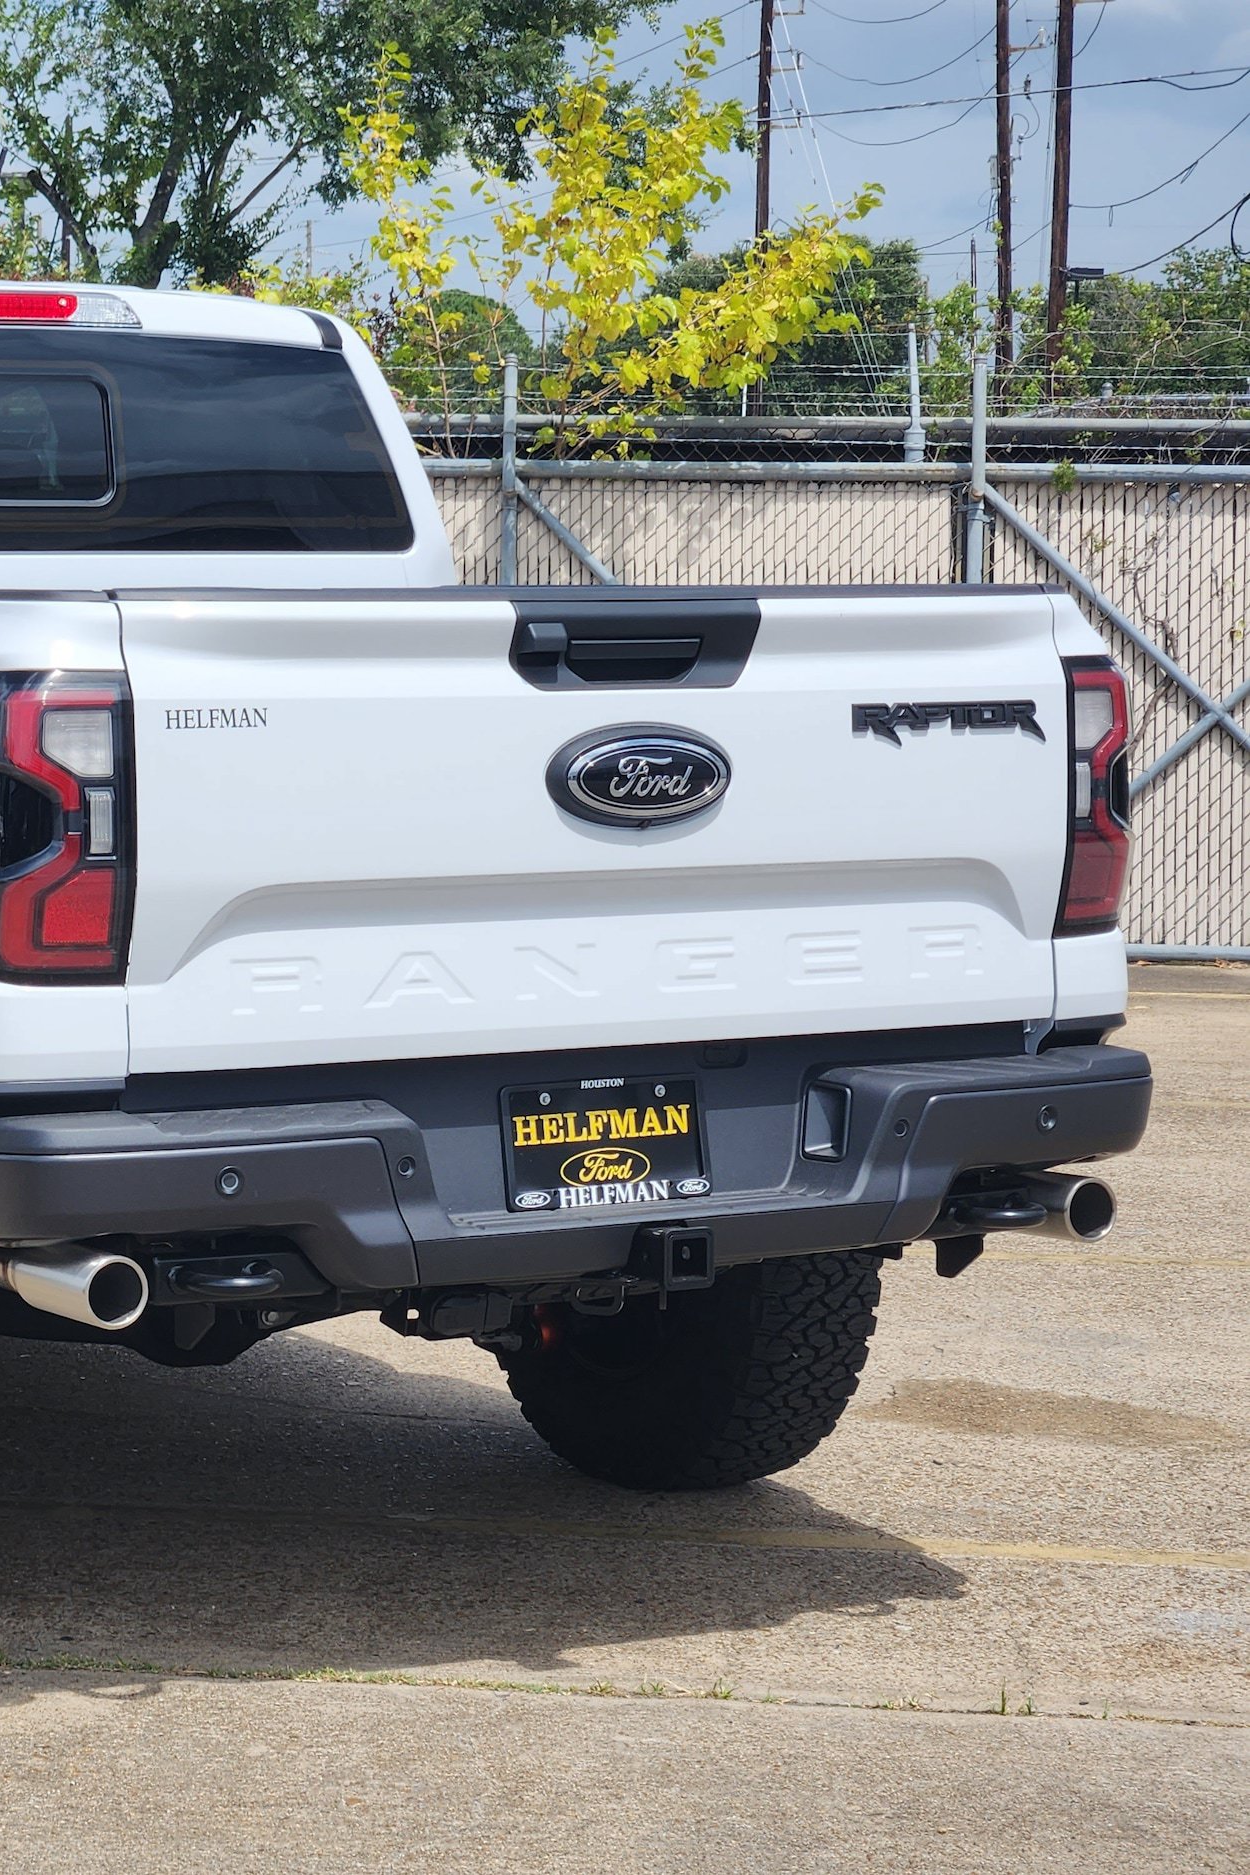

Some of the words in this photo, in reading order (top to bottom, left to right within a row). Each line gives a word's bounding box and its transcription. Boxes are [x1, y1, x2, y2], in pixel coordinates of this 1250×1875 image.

[165, 707, 268, 730] HELFMAN
[851, 699, 1046, 747] RAPTOR
[609, 755, 692, 799] Ford
[229, 923, 984, 1016] RANGER
[580, 1077, 625, 1090] HOUSTON
[512, 1104, 691, 1147] HELFMAN
[578, 1152, 634, 1182] Ford
[558, 1179, 671, 1209] HELFMAN
